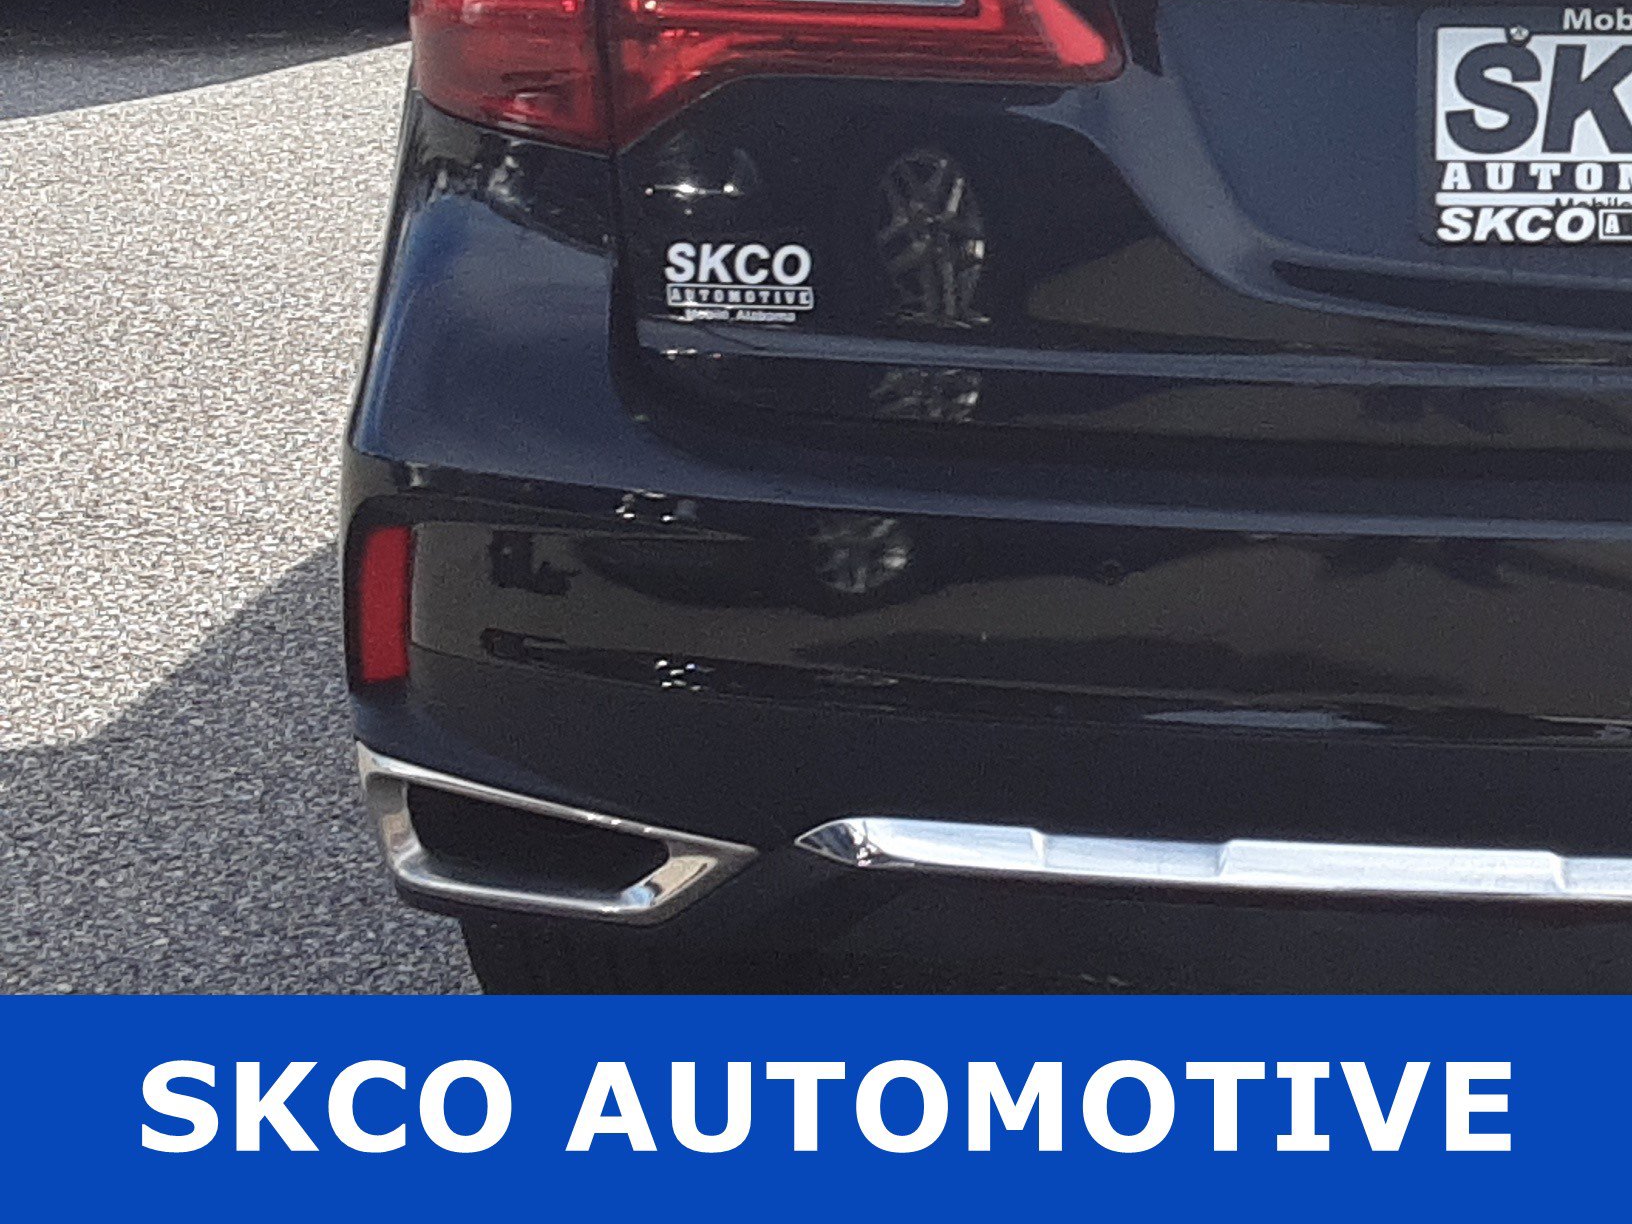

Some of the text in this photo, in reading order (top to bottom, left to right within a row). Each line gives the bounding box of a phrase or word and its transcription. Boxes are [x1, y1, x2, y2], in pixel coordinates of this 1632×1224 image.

[1436, 207, 1597, 244] SKCO
[664, 241, 813, 286] SKCO
[670, 287, 811, 305] AUTOMOTIVE
